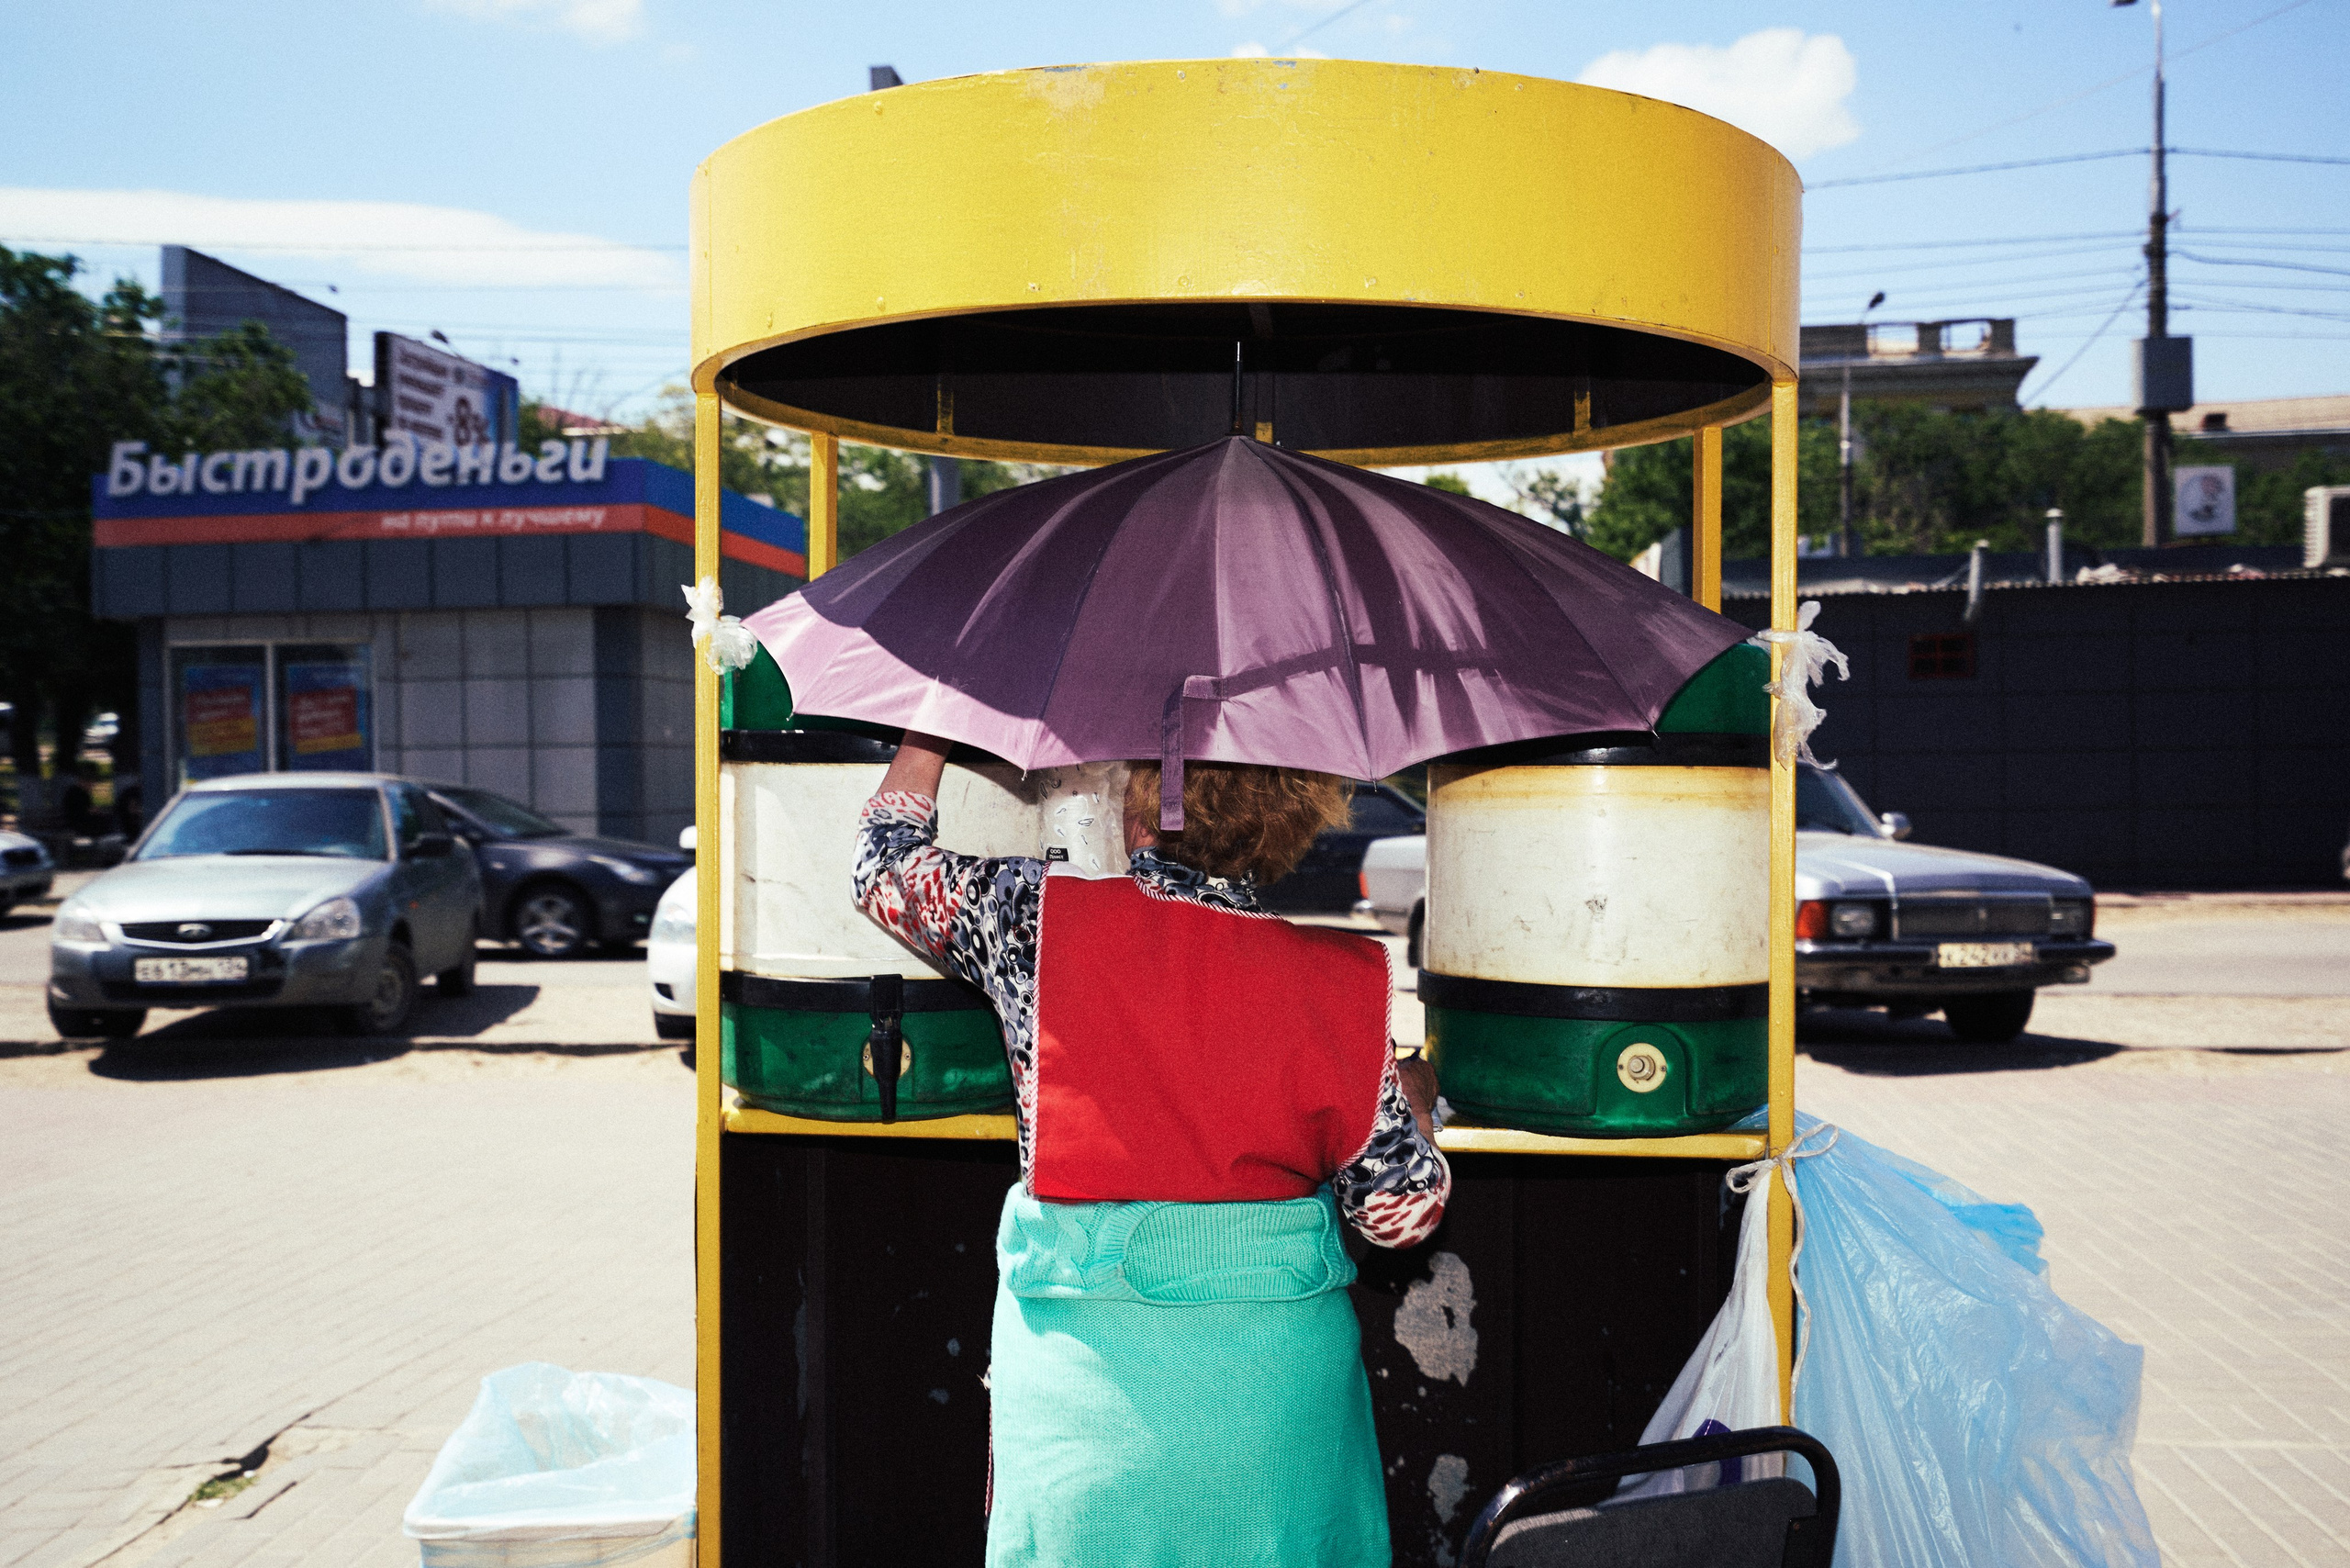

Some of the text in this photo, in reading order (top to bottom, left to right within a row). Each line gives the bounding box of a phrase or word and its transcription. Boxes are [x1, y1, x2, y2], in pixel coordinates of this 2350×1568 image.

[107, 428, 610, 505] Быстроденьги
[413, 511, 477, 533] пути
[499, 509, 607, 532] лучшему
